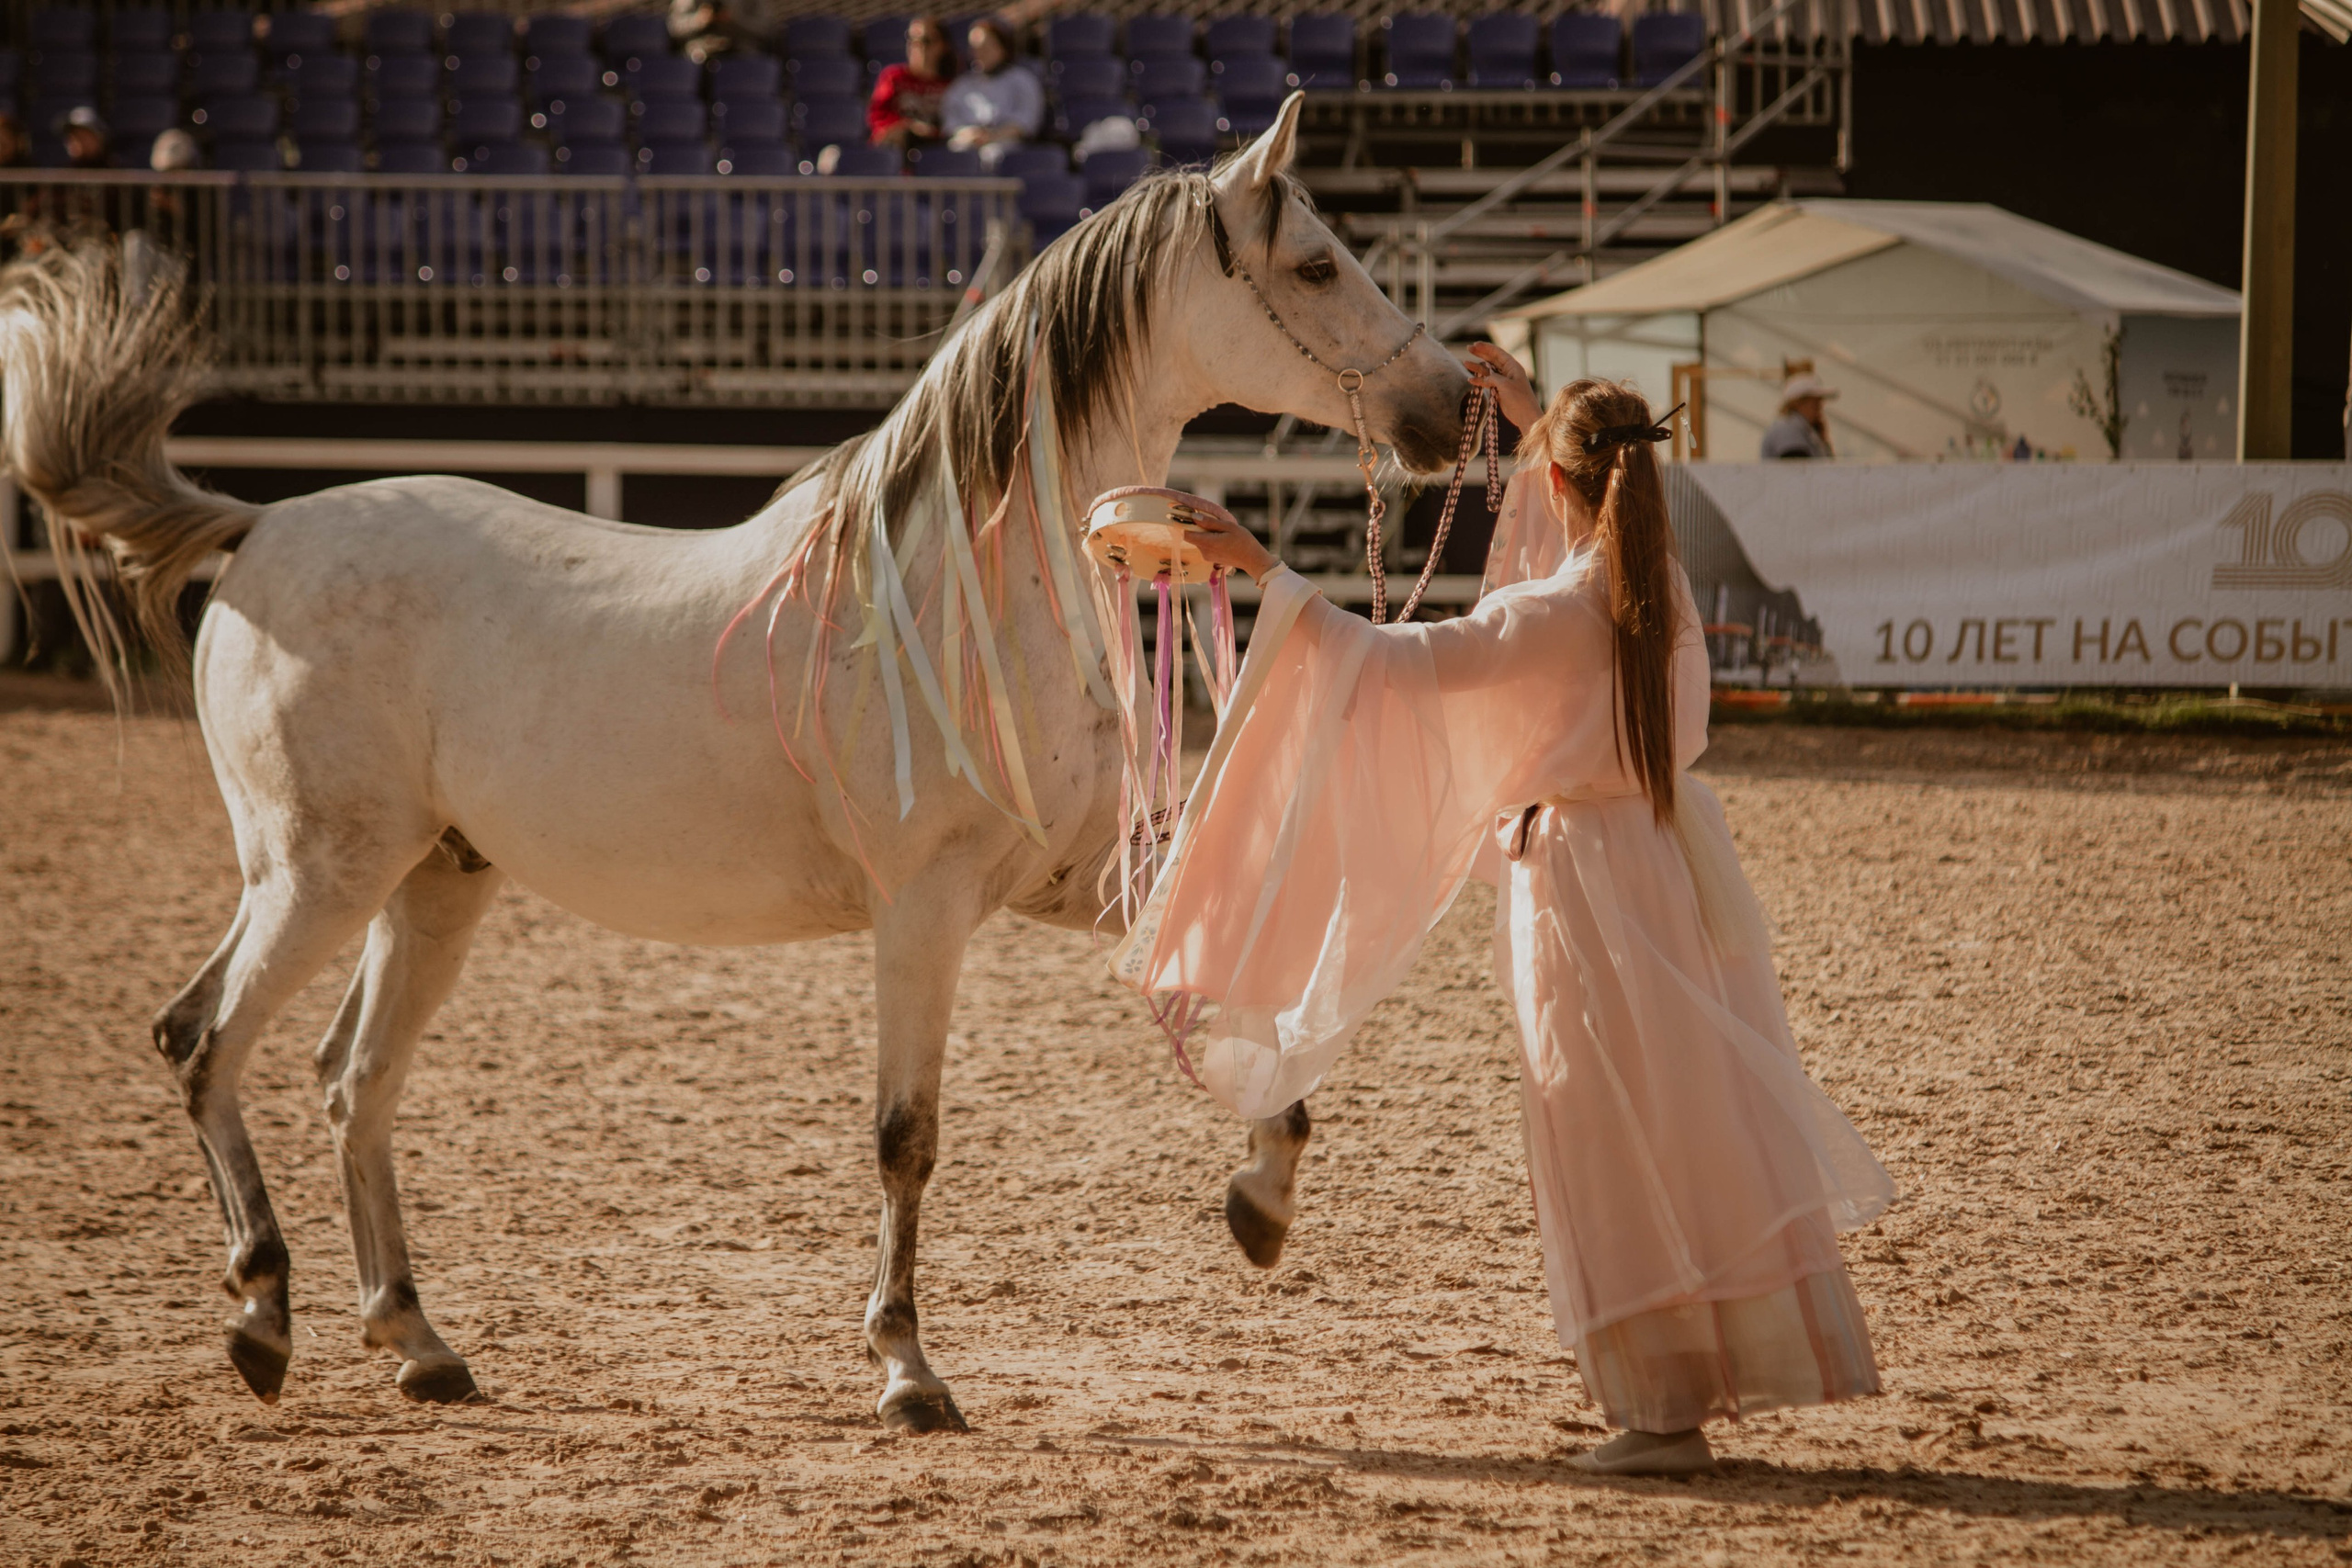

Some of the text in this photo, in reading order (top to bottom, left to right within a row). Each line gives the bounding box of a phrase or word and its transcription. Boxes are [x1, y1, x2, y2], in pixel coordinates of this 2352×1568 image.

[1875, 617, 2352, 664] 10 ЛЕТ НА СОБЫ
